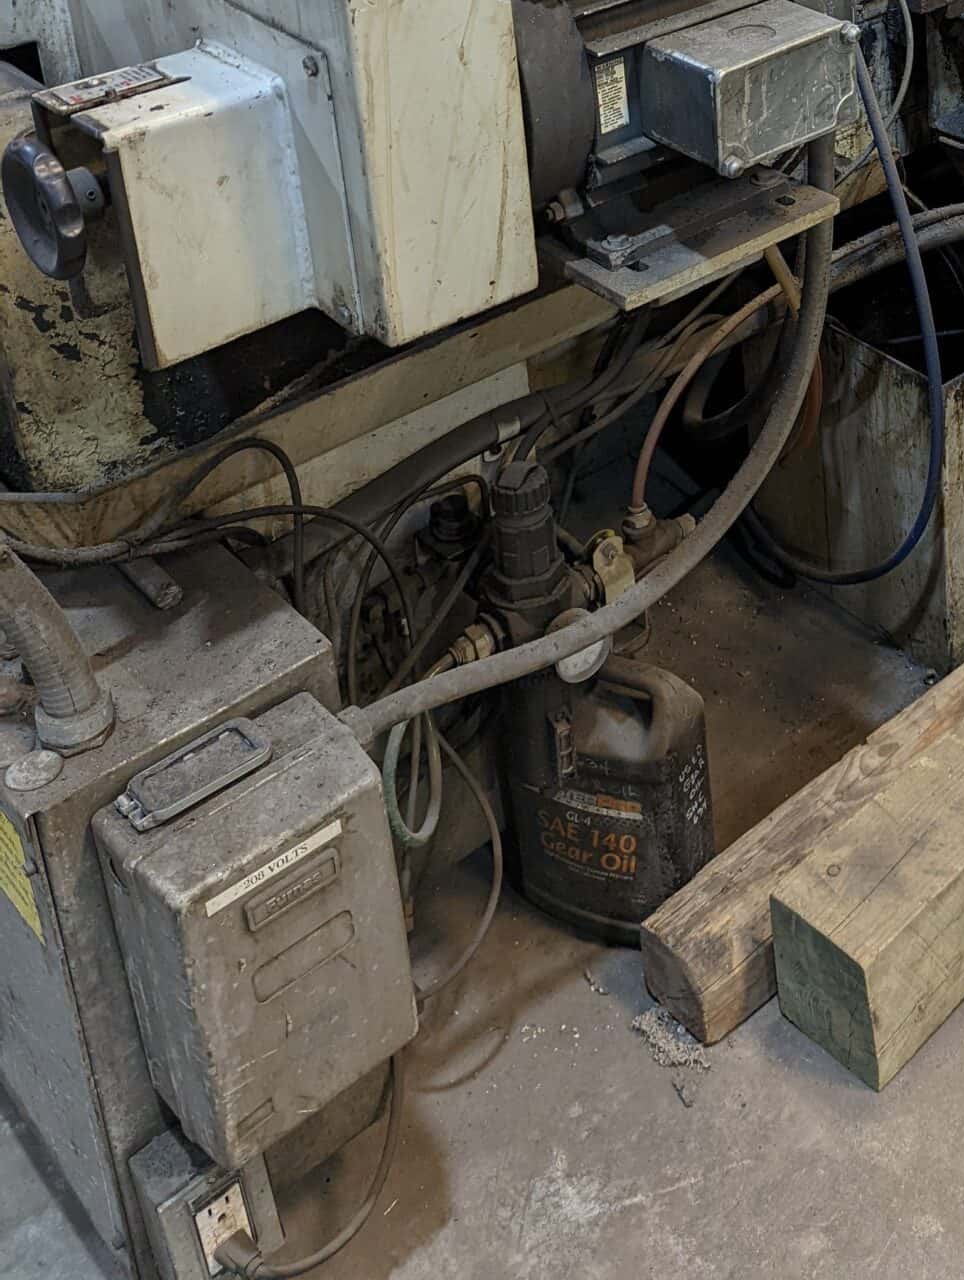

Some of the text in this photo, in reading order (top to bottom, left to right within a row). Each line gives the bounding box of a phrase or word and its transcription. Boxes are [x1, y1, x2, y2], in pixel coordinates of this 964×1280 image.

[539, 809, 637, 855] SAE 140
[542, 832, 594, 864] Gear
[600, 852, 637, 873] Oil
[242, 842, 309, 889] 208 VOLTS
